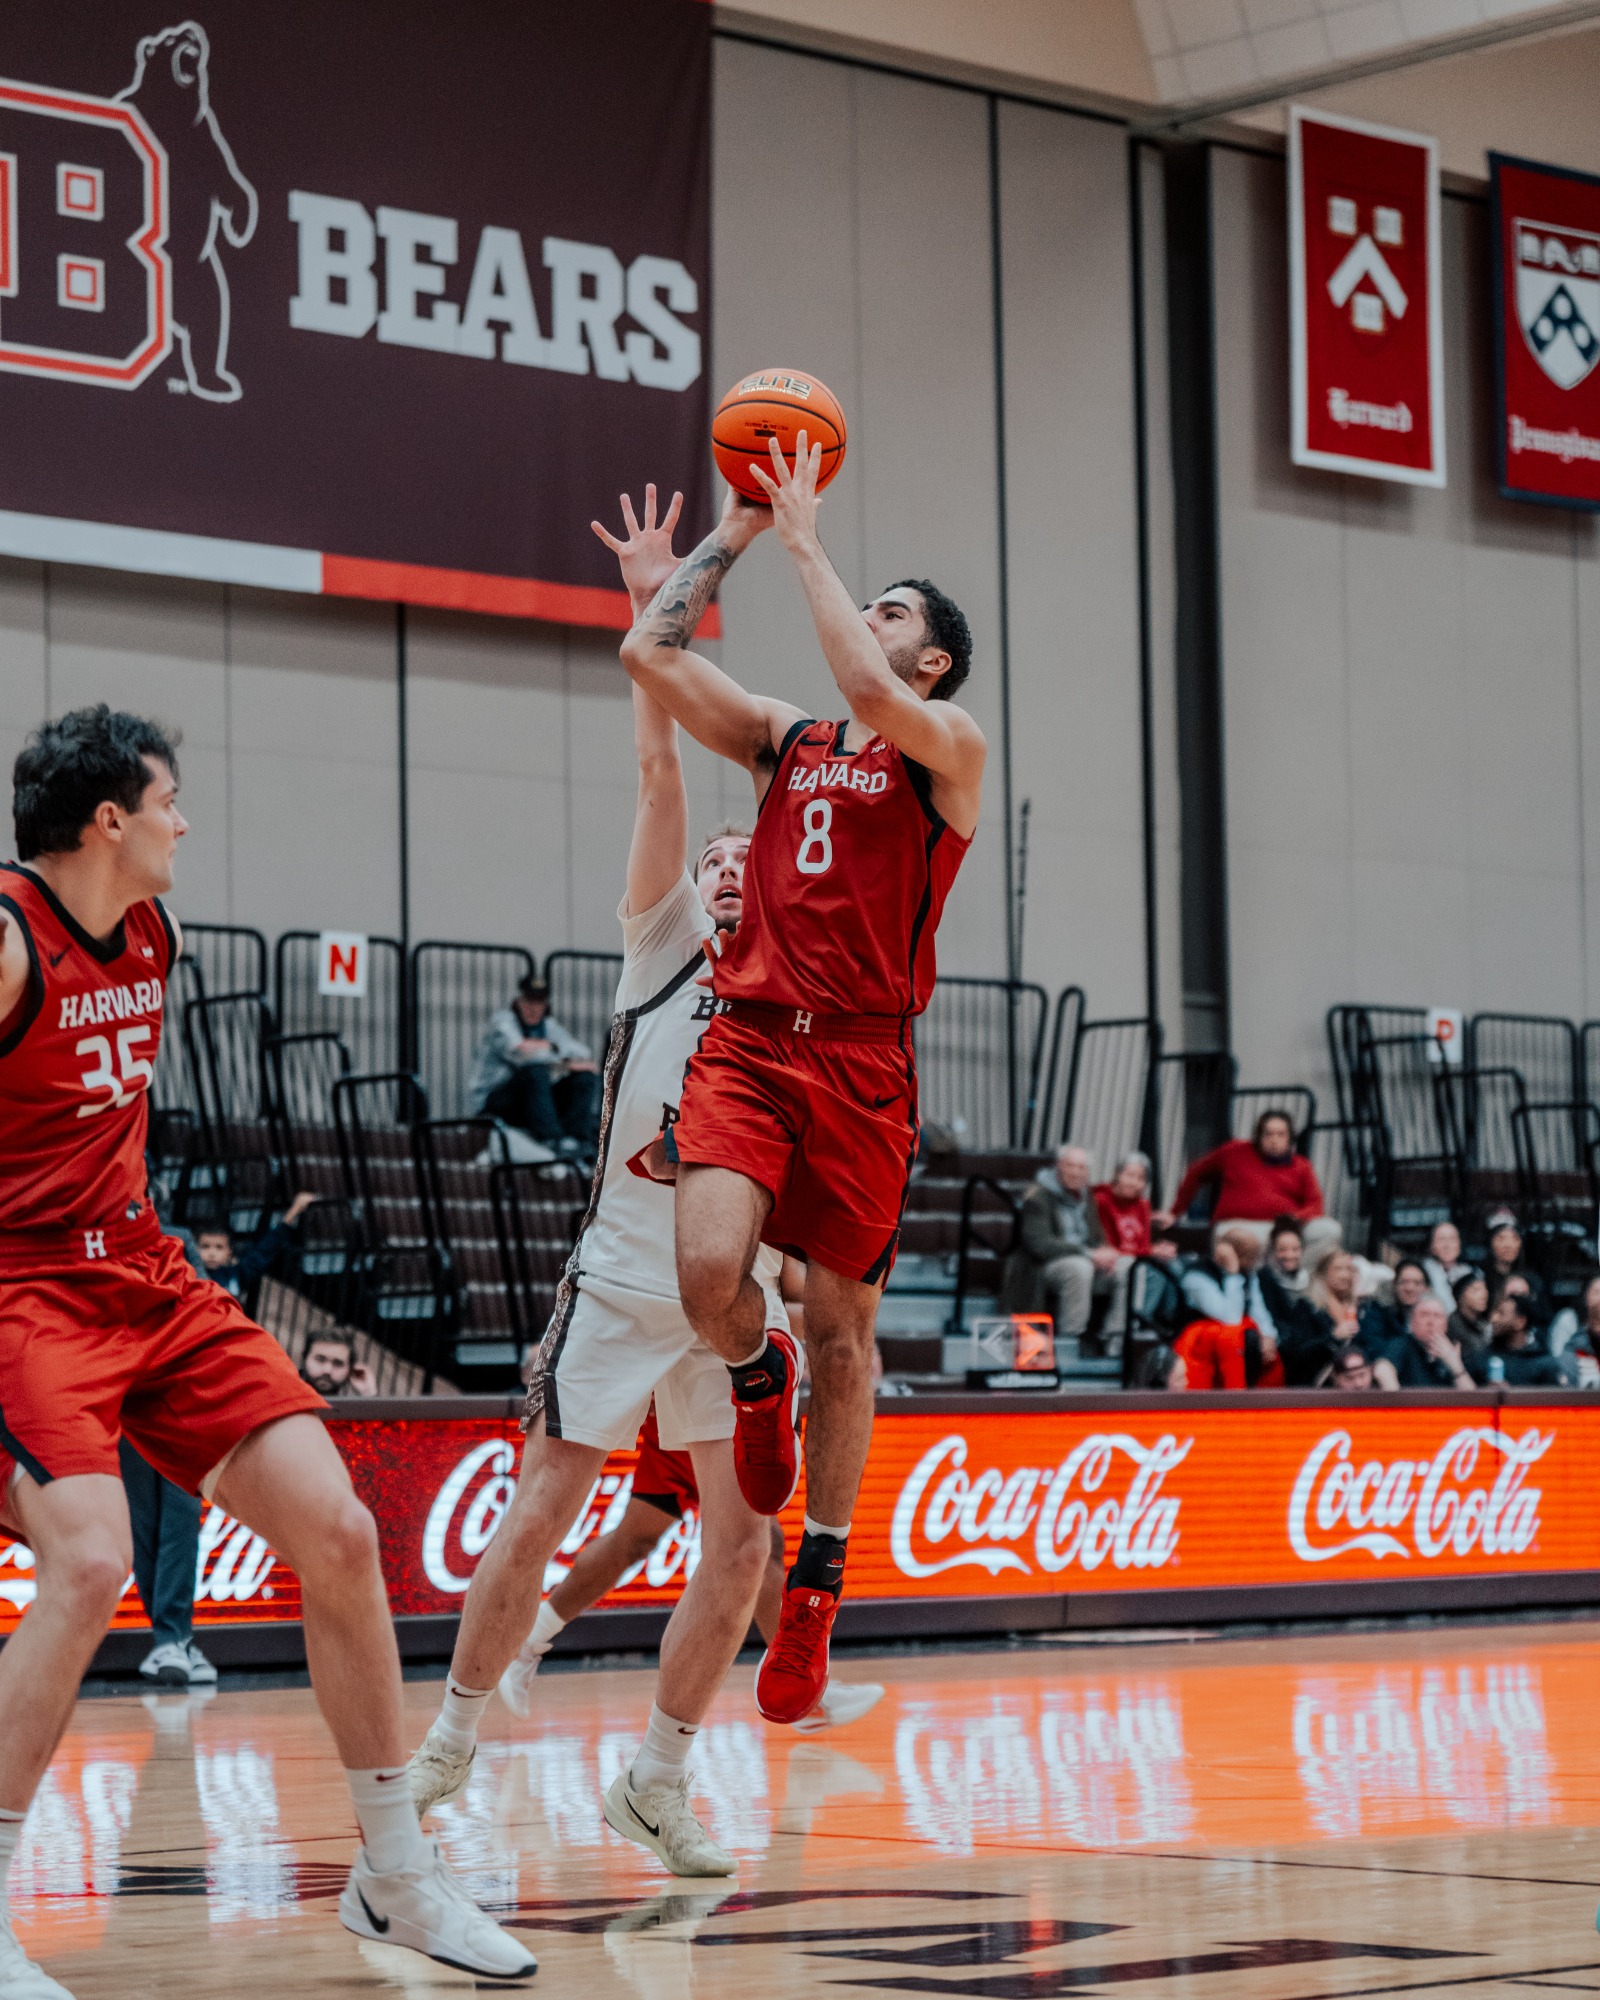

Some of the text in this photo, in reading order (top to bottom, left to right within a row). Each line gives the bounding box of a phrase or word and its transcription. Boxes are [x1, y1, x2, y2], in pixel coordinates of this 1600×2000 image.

[288, 190, 701, 392] BEARS
[738, 386, 808, 400] CHAMPIONSHIP
[740, 375, 812, 396] ELITE
[796, 799, 833, 874] 8
[329, 944, 357, 984] N
[58, 977, 163, 1029] HARVARD
[793, 1009, 814, 1034] H
[76, 1024, 154, 1118] 35
[84, 1230, 107, 1259] H
[891, 1434, 1195, 1578] Coca-Cola
[1288, 1428, 1557, 1562] Coca-Cola
